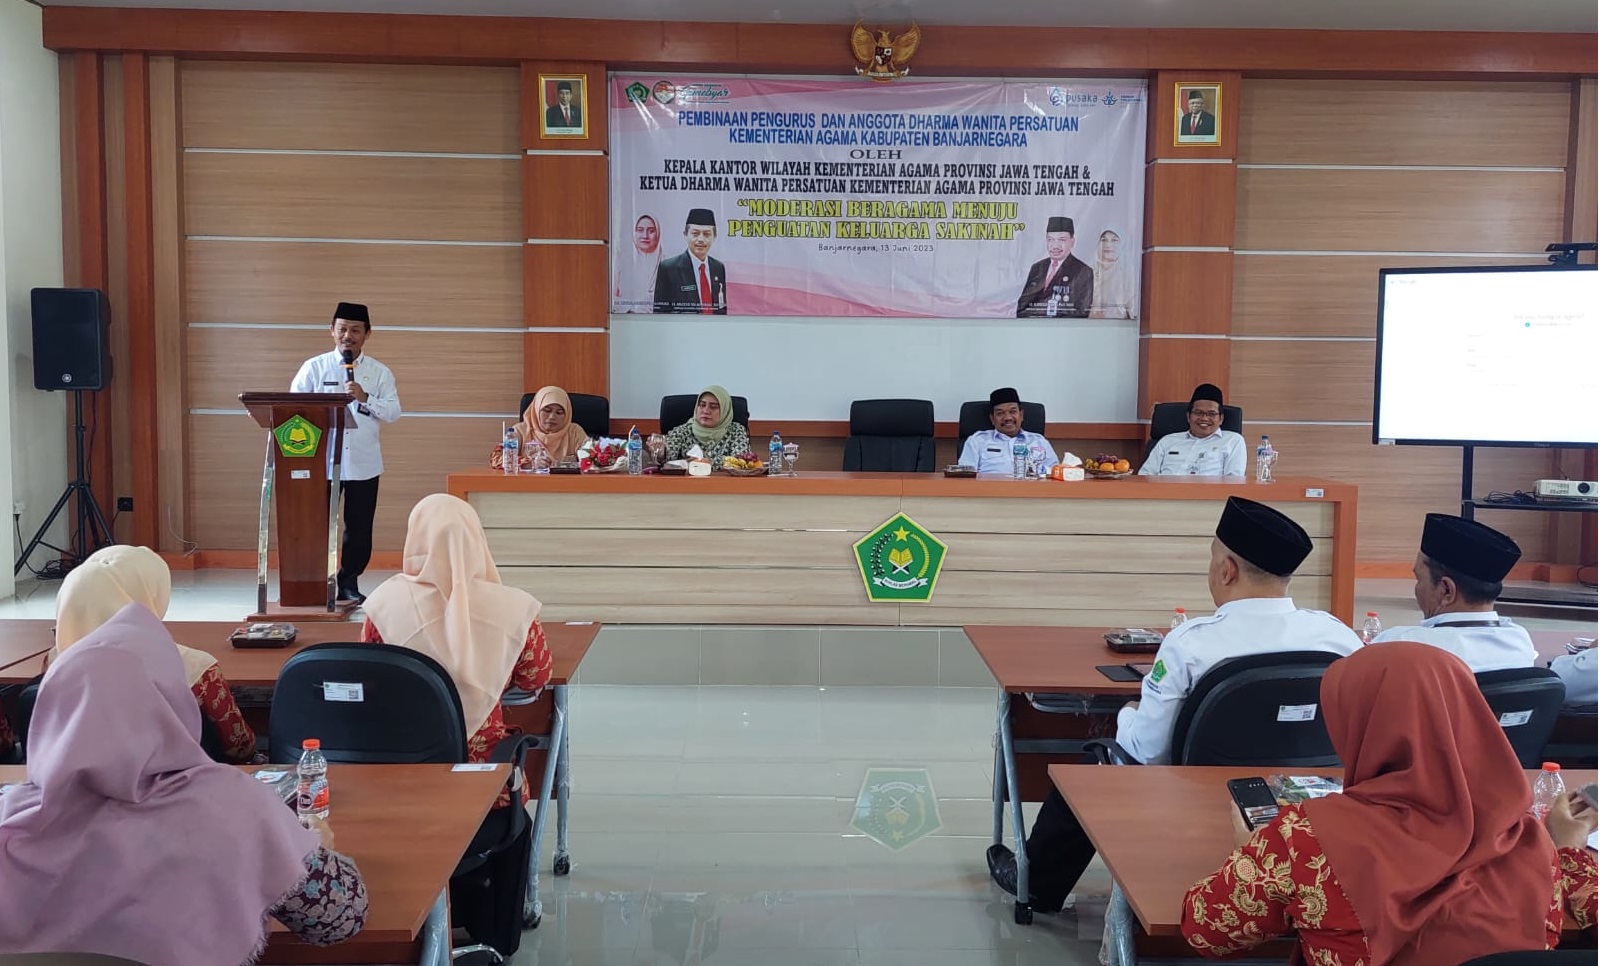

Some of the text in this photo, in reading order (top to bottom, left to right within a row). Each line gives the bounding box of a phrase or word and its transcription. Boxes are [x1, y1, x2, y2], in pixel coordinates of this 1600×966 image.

[678, 111, 1079, 132] PEMBINAAN PENGURUS DAN ANGGOTA DHARMA WANITA PERSATUAN
[729, 128, 1028, 148] KEMENTERIAN AGAMA KABUPATEN BANJARNEGARA
[849, 149, 903, 160] OLEH
[664, 159, 1091, 180] KEPALA KANTOR WILAYAH KEMENTERIAN AGAMA PROVINSI JAWA TENGAH &
[639, 175, 1115, 197] KETUA DHARMA WANITA PERSATUAN KEMENTERIAN AGAMA PROVINSI JAWA TENGAH
[846, 200, 947, 219] BERAGAMA
[952, 202, 1019, 221] MENUJU
[727, 220, 831, 238] PENGUATAN
[836, 221, 930, 240] KELUARGA
[818, 243, 934, 255] Banjarnegara, 13 Juni 2023
